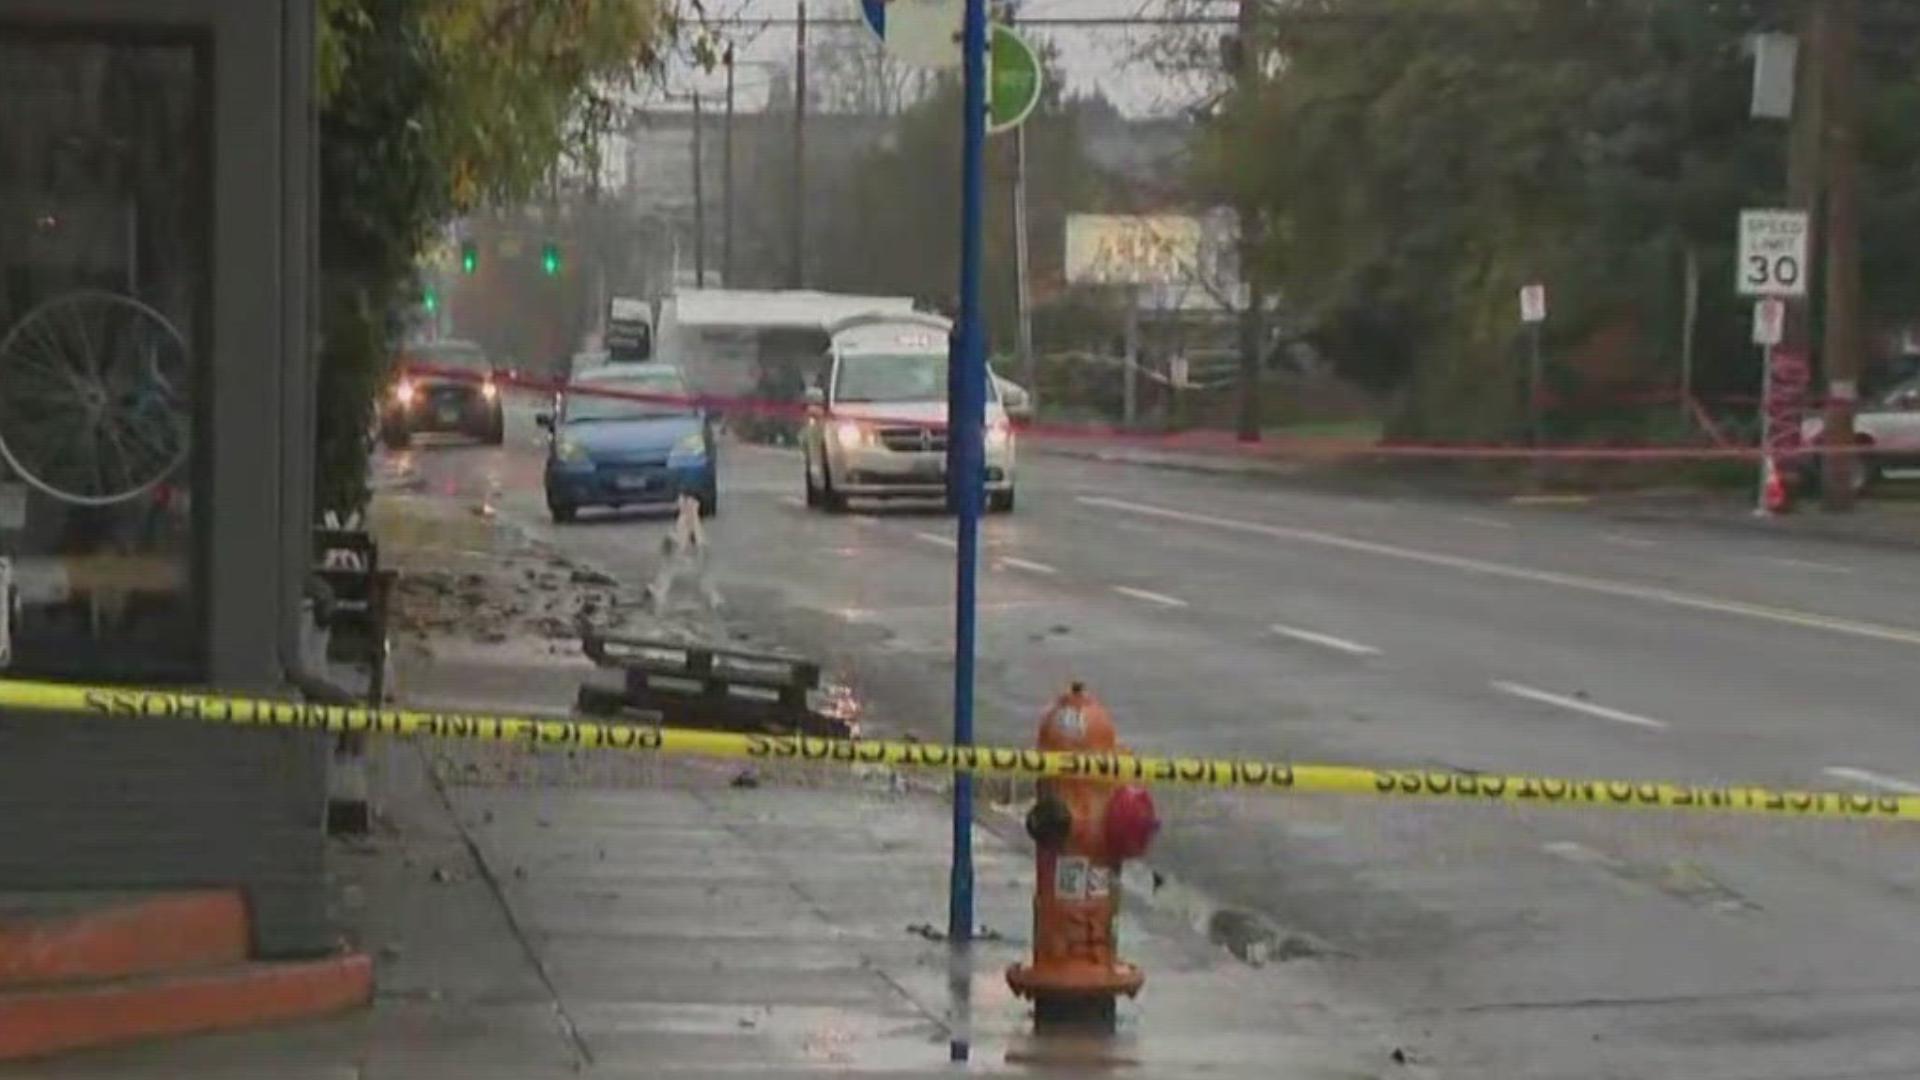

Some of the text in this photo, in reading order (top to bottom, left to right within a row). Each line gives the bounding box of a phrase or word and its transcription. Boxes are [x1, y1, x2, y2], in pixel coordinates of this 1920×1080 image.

[1748, 219, 1803, 234] SPEED
[1747, 254, 1798, 286] 30
[517, 720, 662, 748] POLICE
[746, 735, 1295, 787] POLICE LINE DO NOT CROSS
[1375, 770, 1506, 798] CROSS
[1515, 777, 1595, 800] NOT
[1607, 781, 1660, 803] DO
[1765, 789, 1900, 814] POLICE
